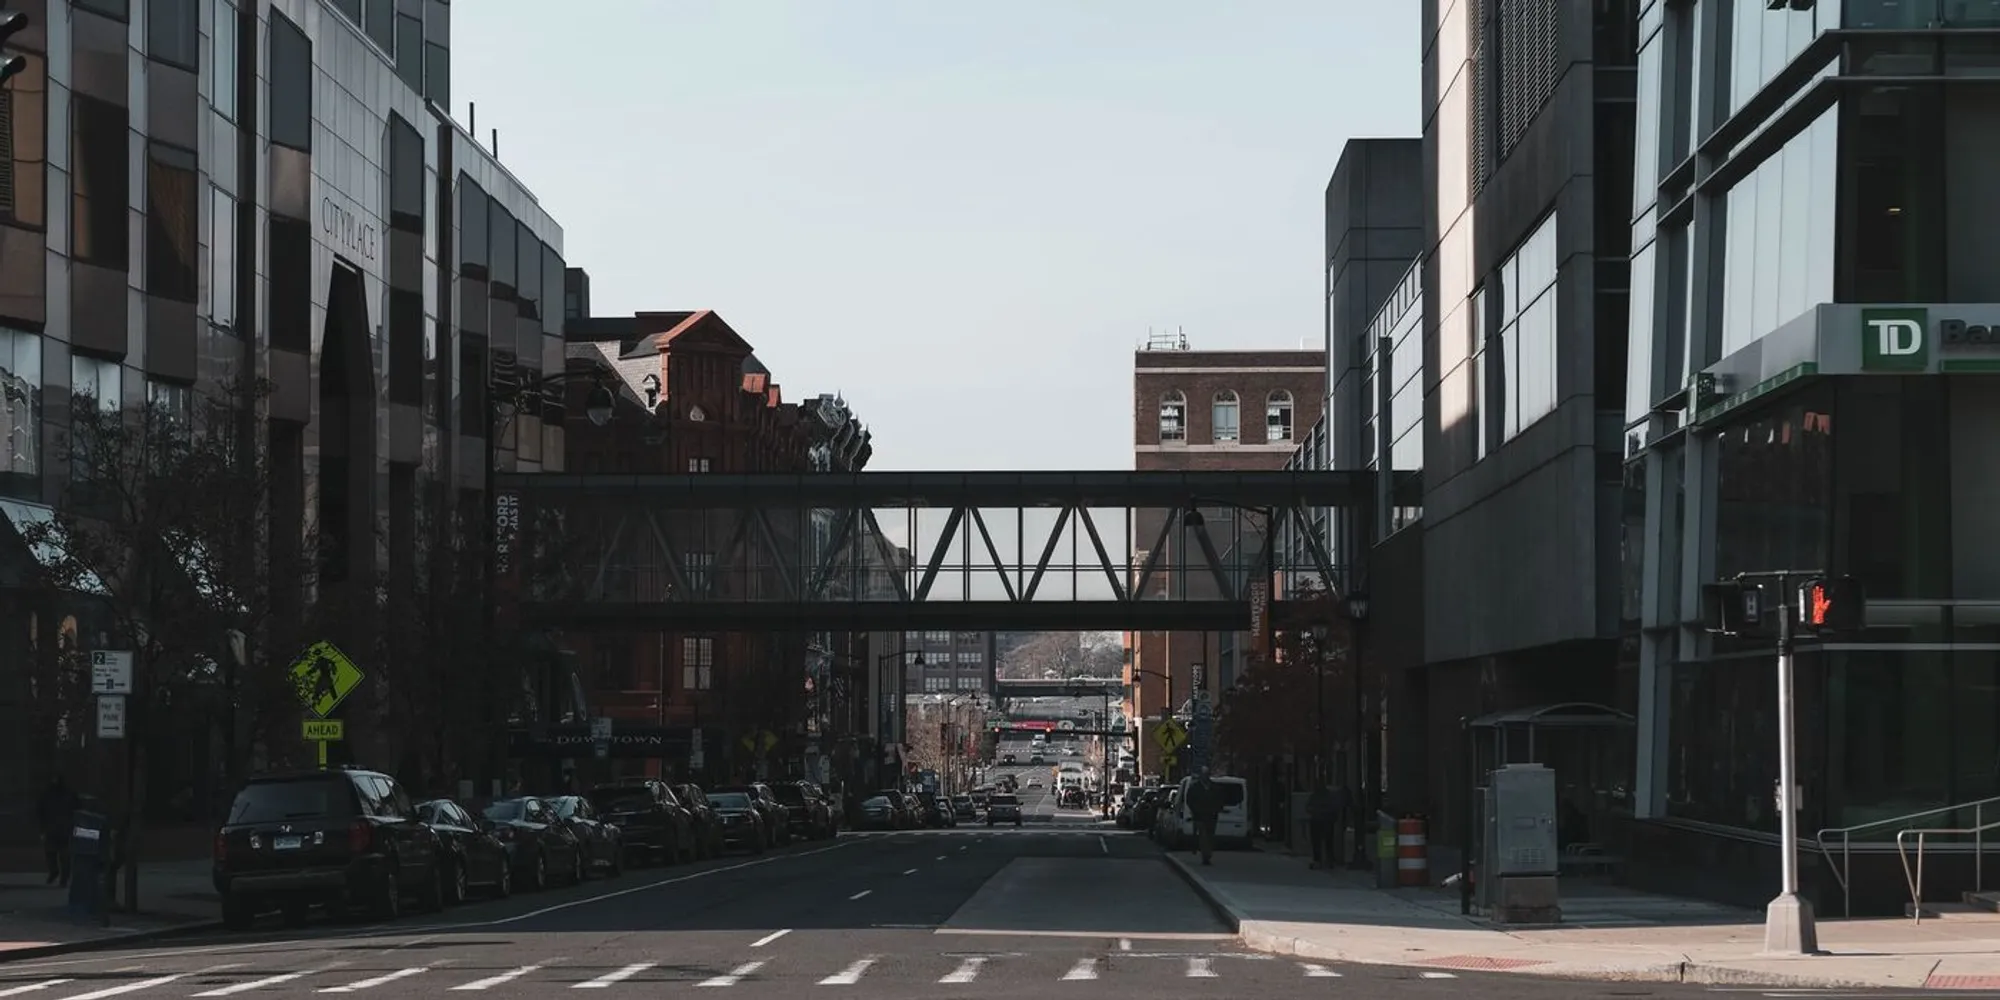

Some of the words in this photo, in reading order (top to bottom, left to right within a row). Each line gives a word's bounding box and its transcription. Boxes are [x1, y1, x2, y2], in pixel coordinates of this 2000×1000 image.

[322, 197, 374, 260] CITYPLACE
[1868, 319, 1922, 355] TD
[497, 495, 508, 573] HARFORD
[308, 726, 338, 735] AHEAD
[557, 736, 662, 744] DOWTOWN
